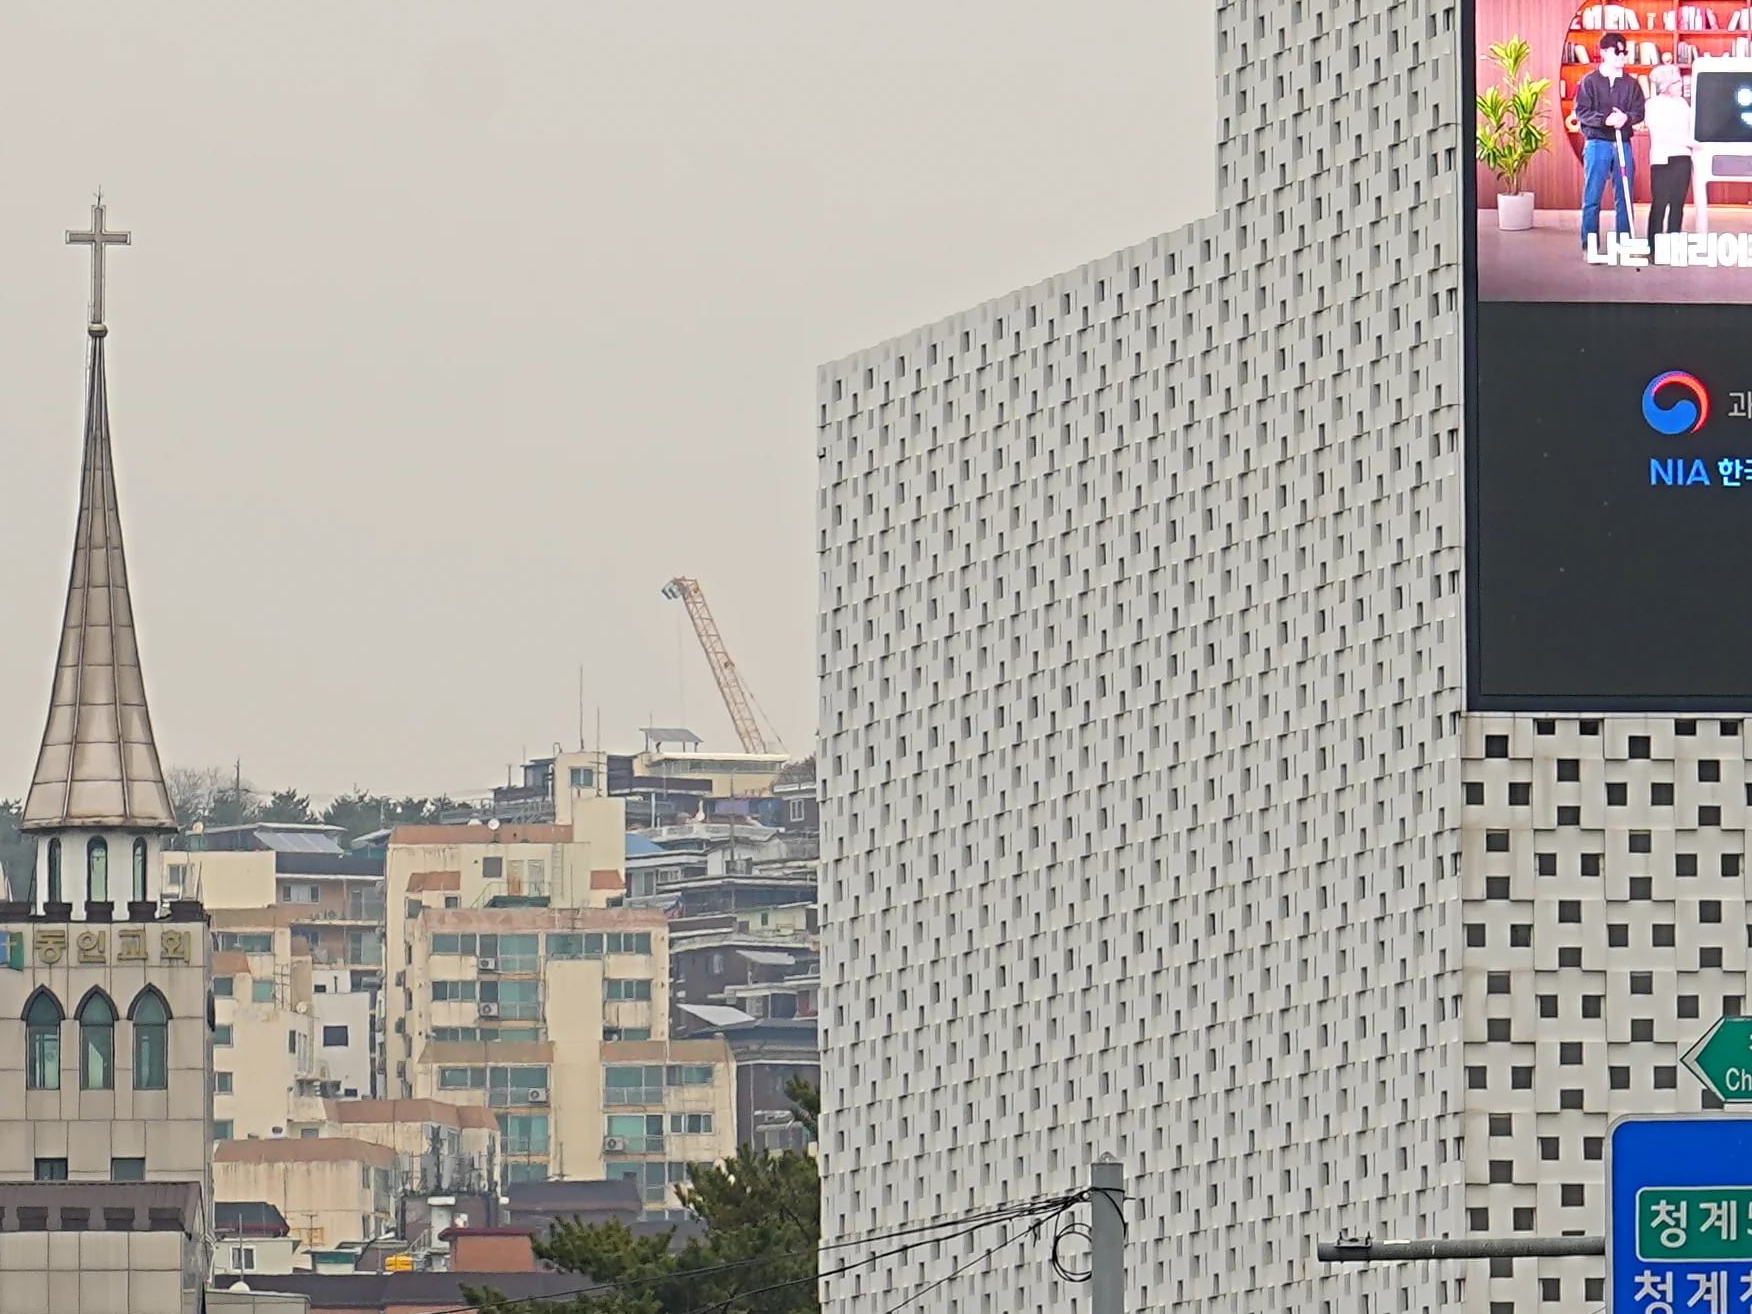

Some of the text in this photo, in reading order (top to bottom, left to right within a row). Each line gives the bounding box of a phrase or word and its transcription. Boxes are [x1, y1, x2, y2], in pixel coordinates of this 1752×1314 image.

[1587, 232, 1651, 267] 나는
[1650, 458, 1711, 487] NIA
[35, 929, 191, 964] 동인교회
